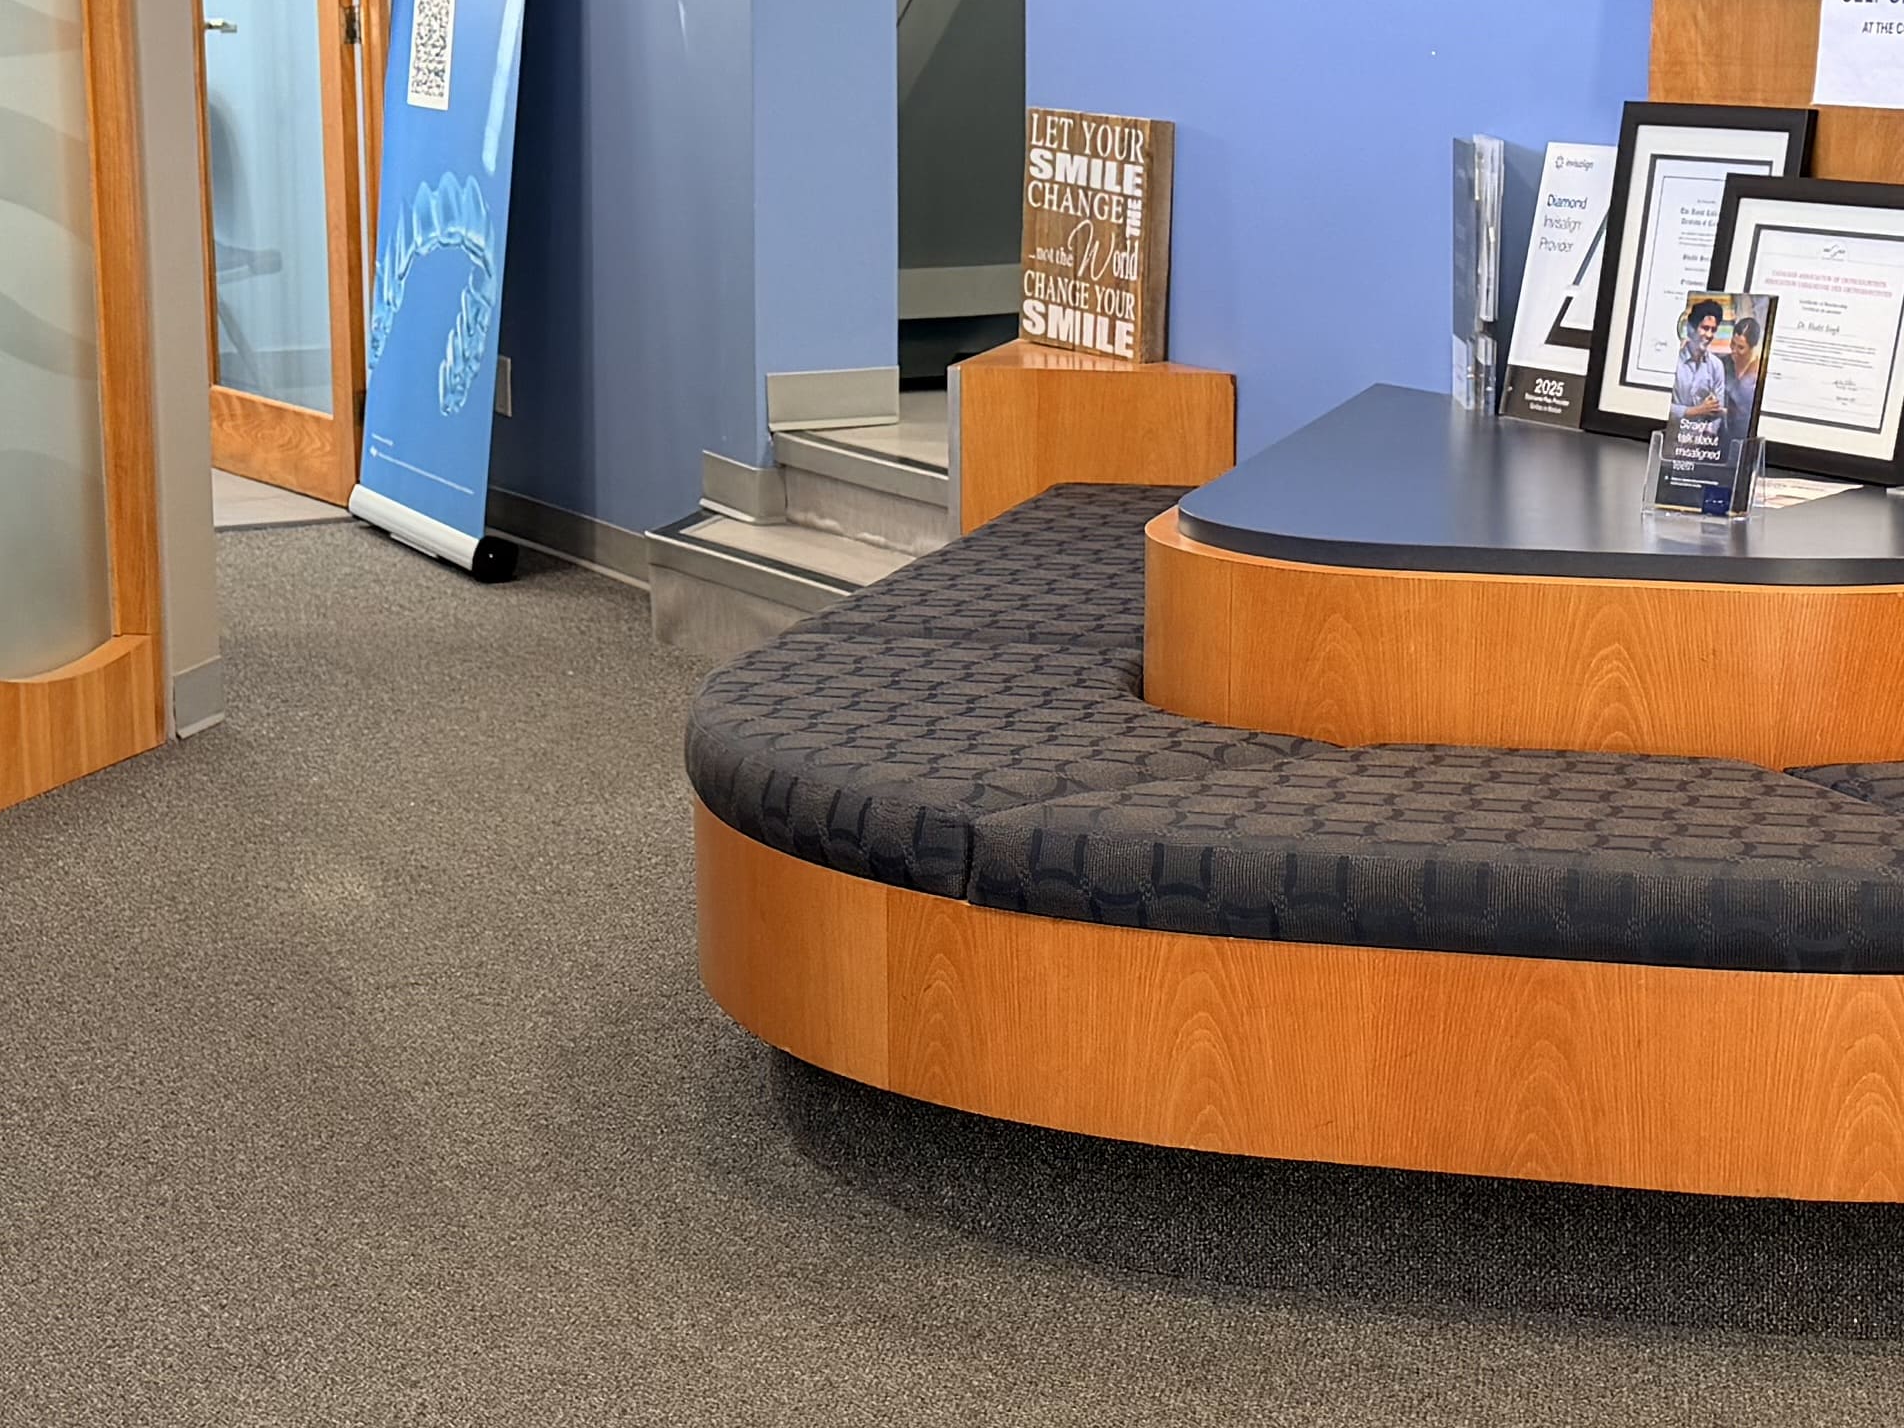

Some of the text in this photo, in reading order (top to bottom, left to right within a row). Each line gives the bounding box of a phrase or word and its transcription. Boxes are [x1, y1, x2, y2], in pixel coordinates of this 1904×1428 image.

[1862, 21, 1874, 34] AT
[1876, 22, 1894, 34] THE
[1030, 113, 1144, 163] LET YOUR
[1029, 148, 1144, 197] SMILE
[1027, 180, 1124, 224] CHANGE
[1125, 198, 1143, 239] THE
[1547, 194, 1588, 209] Diamond
[1056, 246, 1074, 267] the
[1067, 219, 1139, 282] World
[1023, 269, 1136, 321] CHANGE YOUR
[1022, 298, 1135, 359] SMILE
[1534, 378, 1565, 397] 2025
[1675, 447, 1721, 461] misaligned
[1677, 432, 1719, 446] talk about
